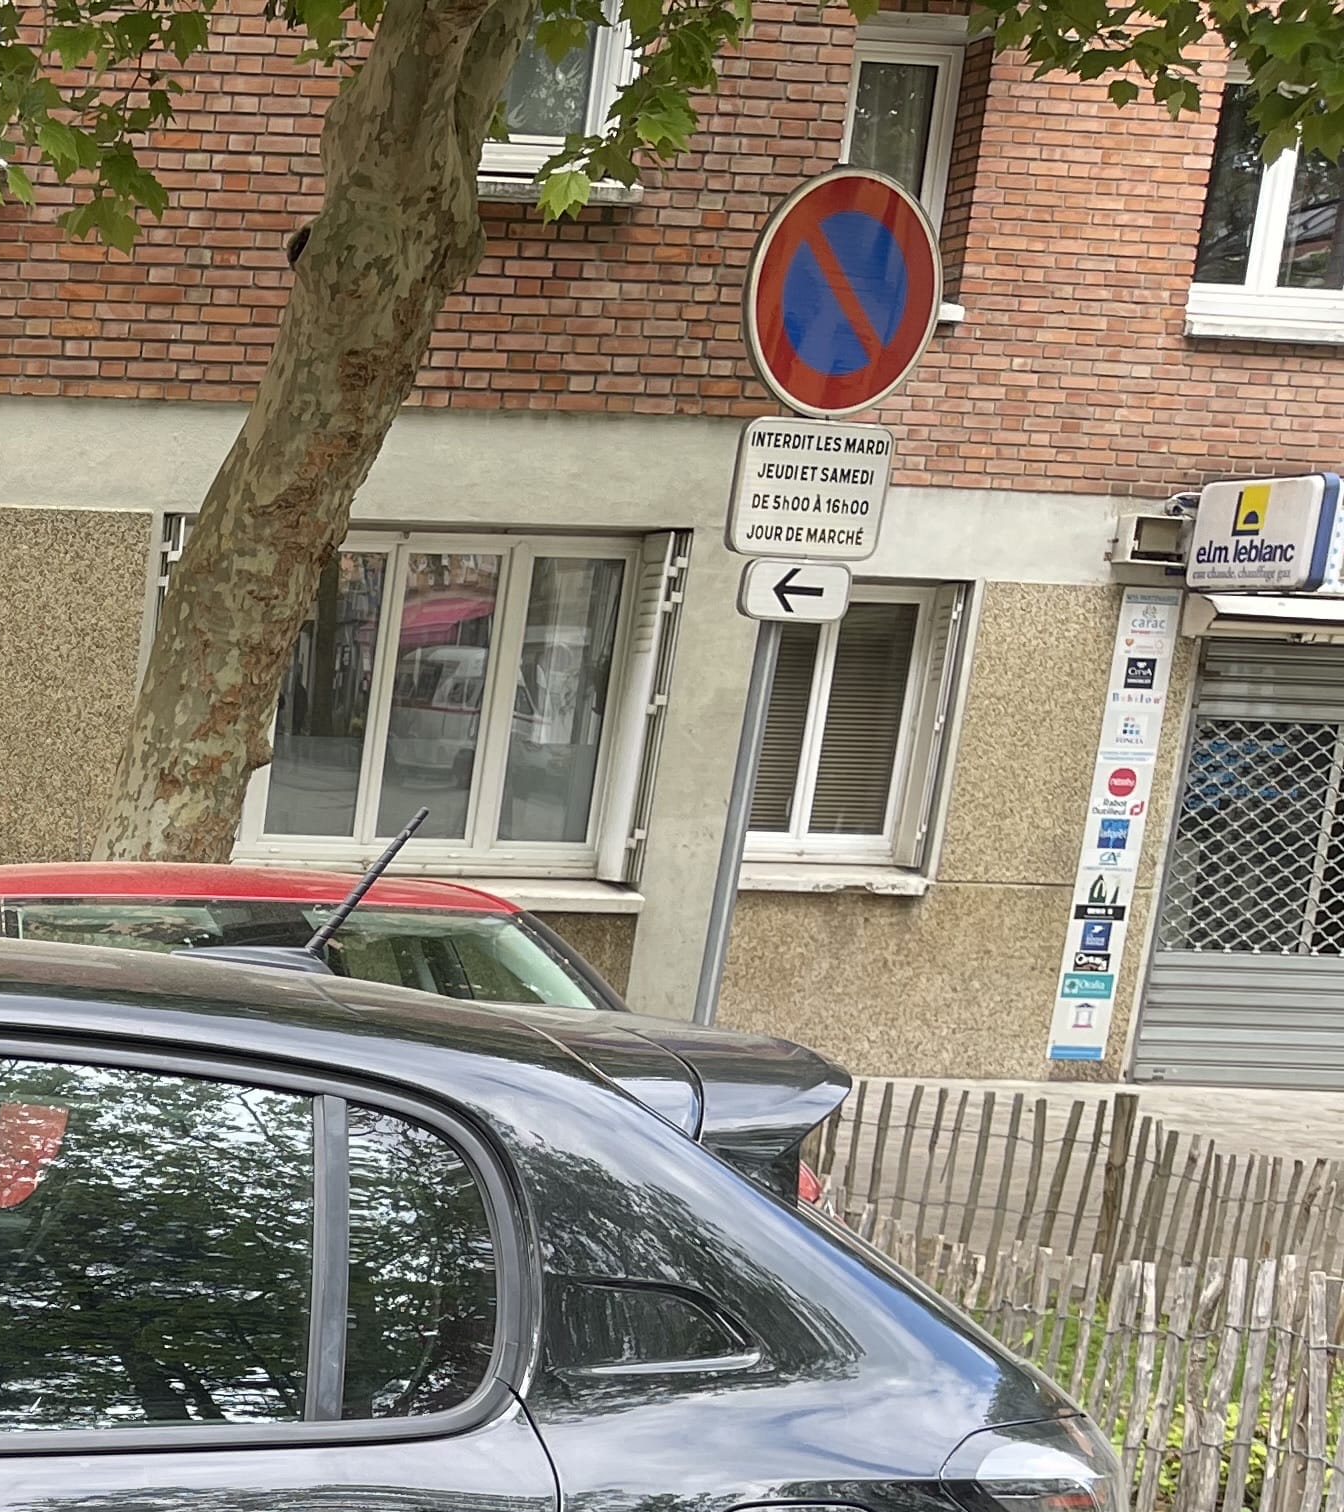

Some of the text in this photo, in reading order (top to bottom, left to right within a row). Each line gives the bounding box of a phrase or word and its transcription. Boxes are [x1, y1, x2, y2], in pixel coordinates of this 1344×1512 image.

[751, 431, 890, 456] INTERDIT LES MARDI
[757, 463, 875, 485] JEUDI ET SAMEDI
[751, 493, 770, 509] DE
[772, 496, 810, 511] 5h00
[825, 498, 869, 515] 16h00
[746, 524, 864, 545] JOUR DE MARCHÉ
[1232, 538, 1295, 563] leblanc
[1131, 618, 1166, 629] carac
